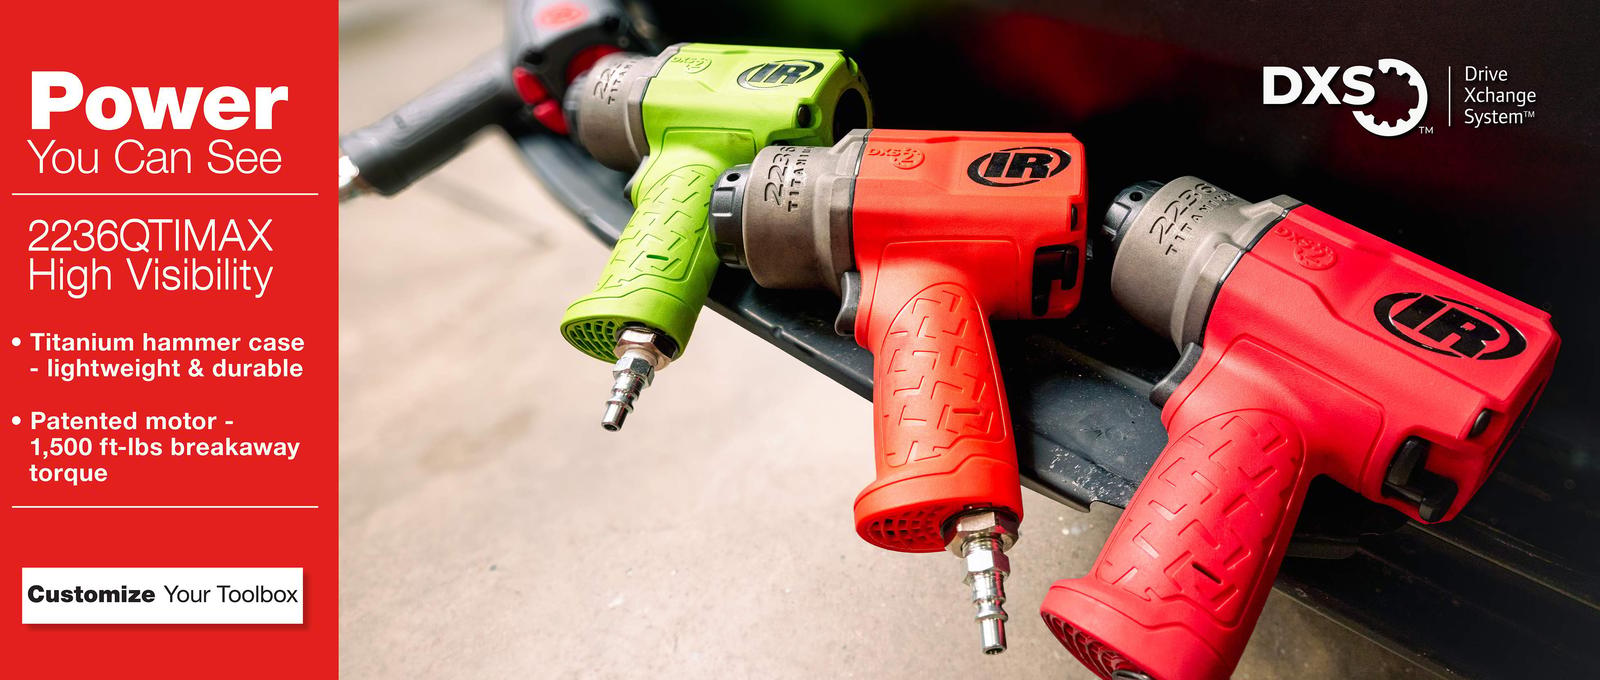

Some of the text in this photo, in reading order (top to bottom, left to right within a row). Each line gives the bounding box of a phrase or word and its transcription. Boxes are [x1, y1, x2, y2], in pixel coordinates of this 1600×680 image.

[750, 63, 803, 85] IR
[983, 152, 1052, 180] IR
[1149, 183, 1215, 245] 2236
[1389, 294, 1502, 359] IR
